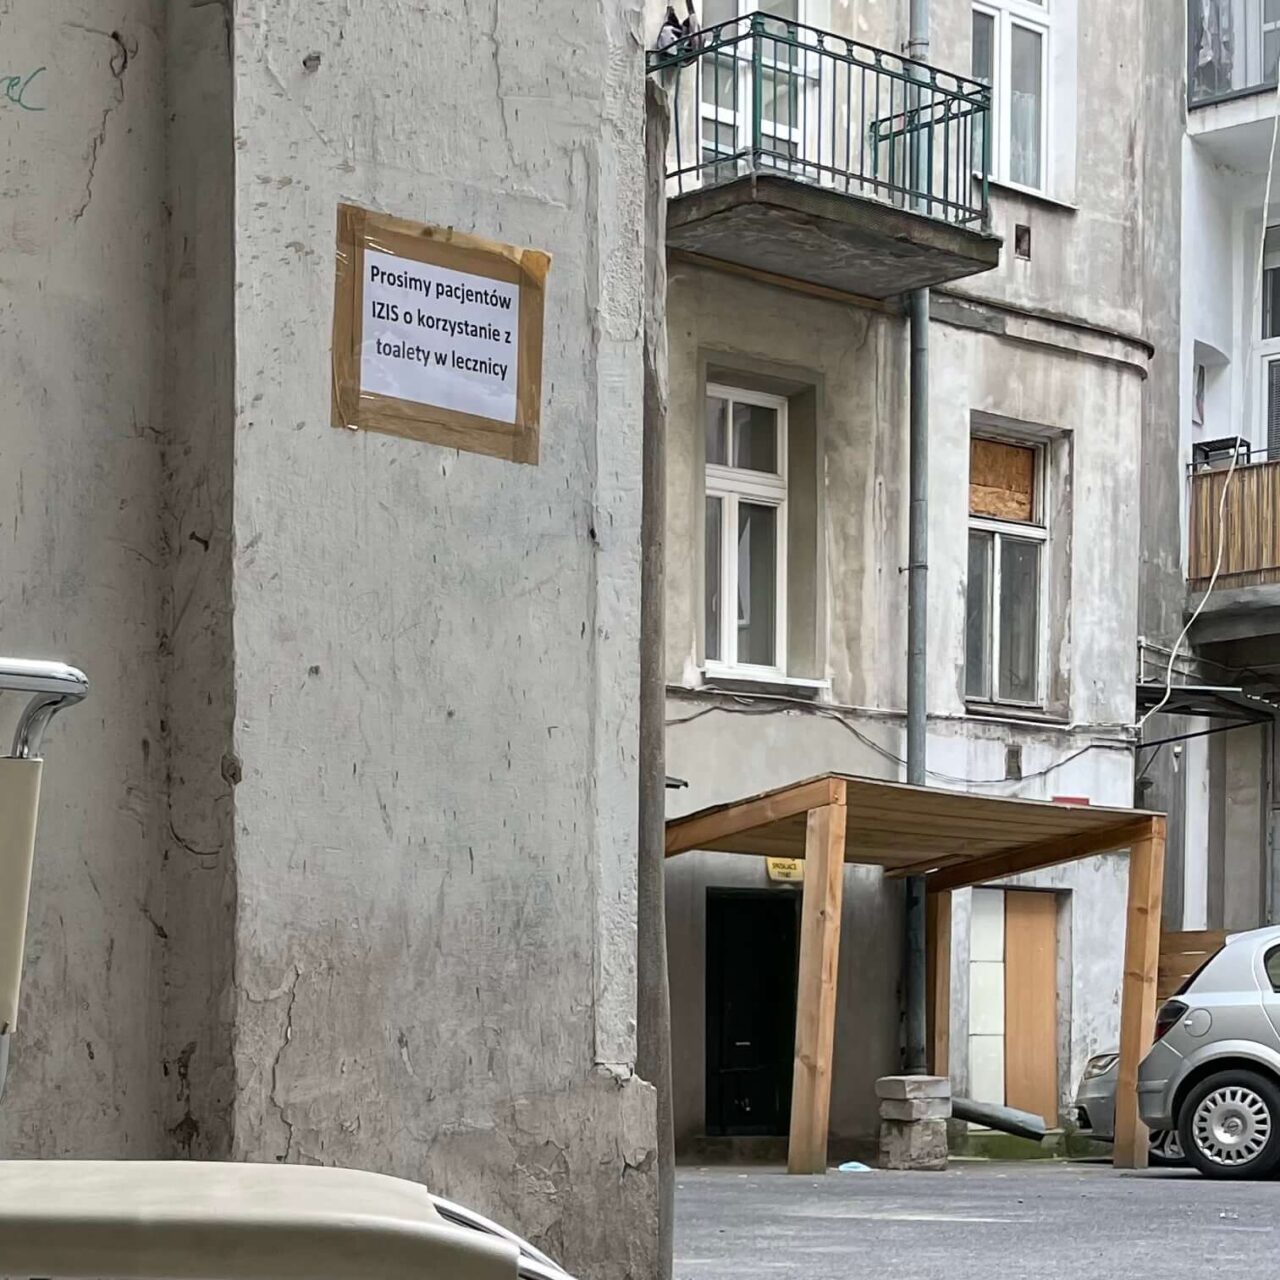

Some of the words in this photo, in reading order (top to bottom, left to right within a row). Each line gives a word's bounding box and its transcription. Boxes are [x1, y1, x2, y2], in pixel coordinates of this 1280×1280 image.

[370, 265, 431, 298] Prosimy
[436, 282, 512, 310] pacjentów
[372, 301, 399, 322] IZIS
[403, 311, 413, 324] o
[417, 308, 501, 342] korzystanie
[504, 331, 512, 344] z
[376, 338, 431, 367] toalety
[434, 352, 448, 366] w
[452, 350, 508, 381] lecznicy
